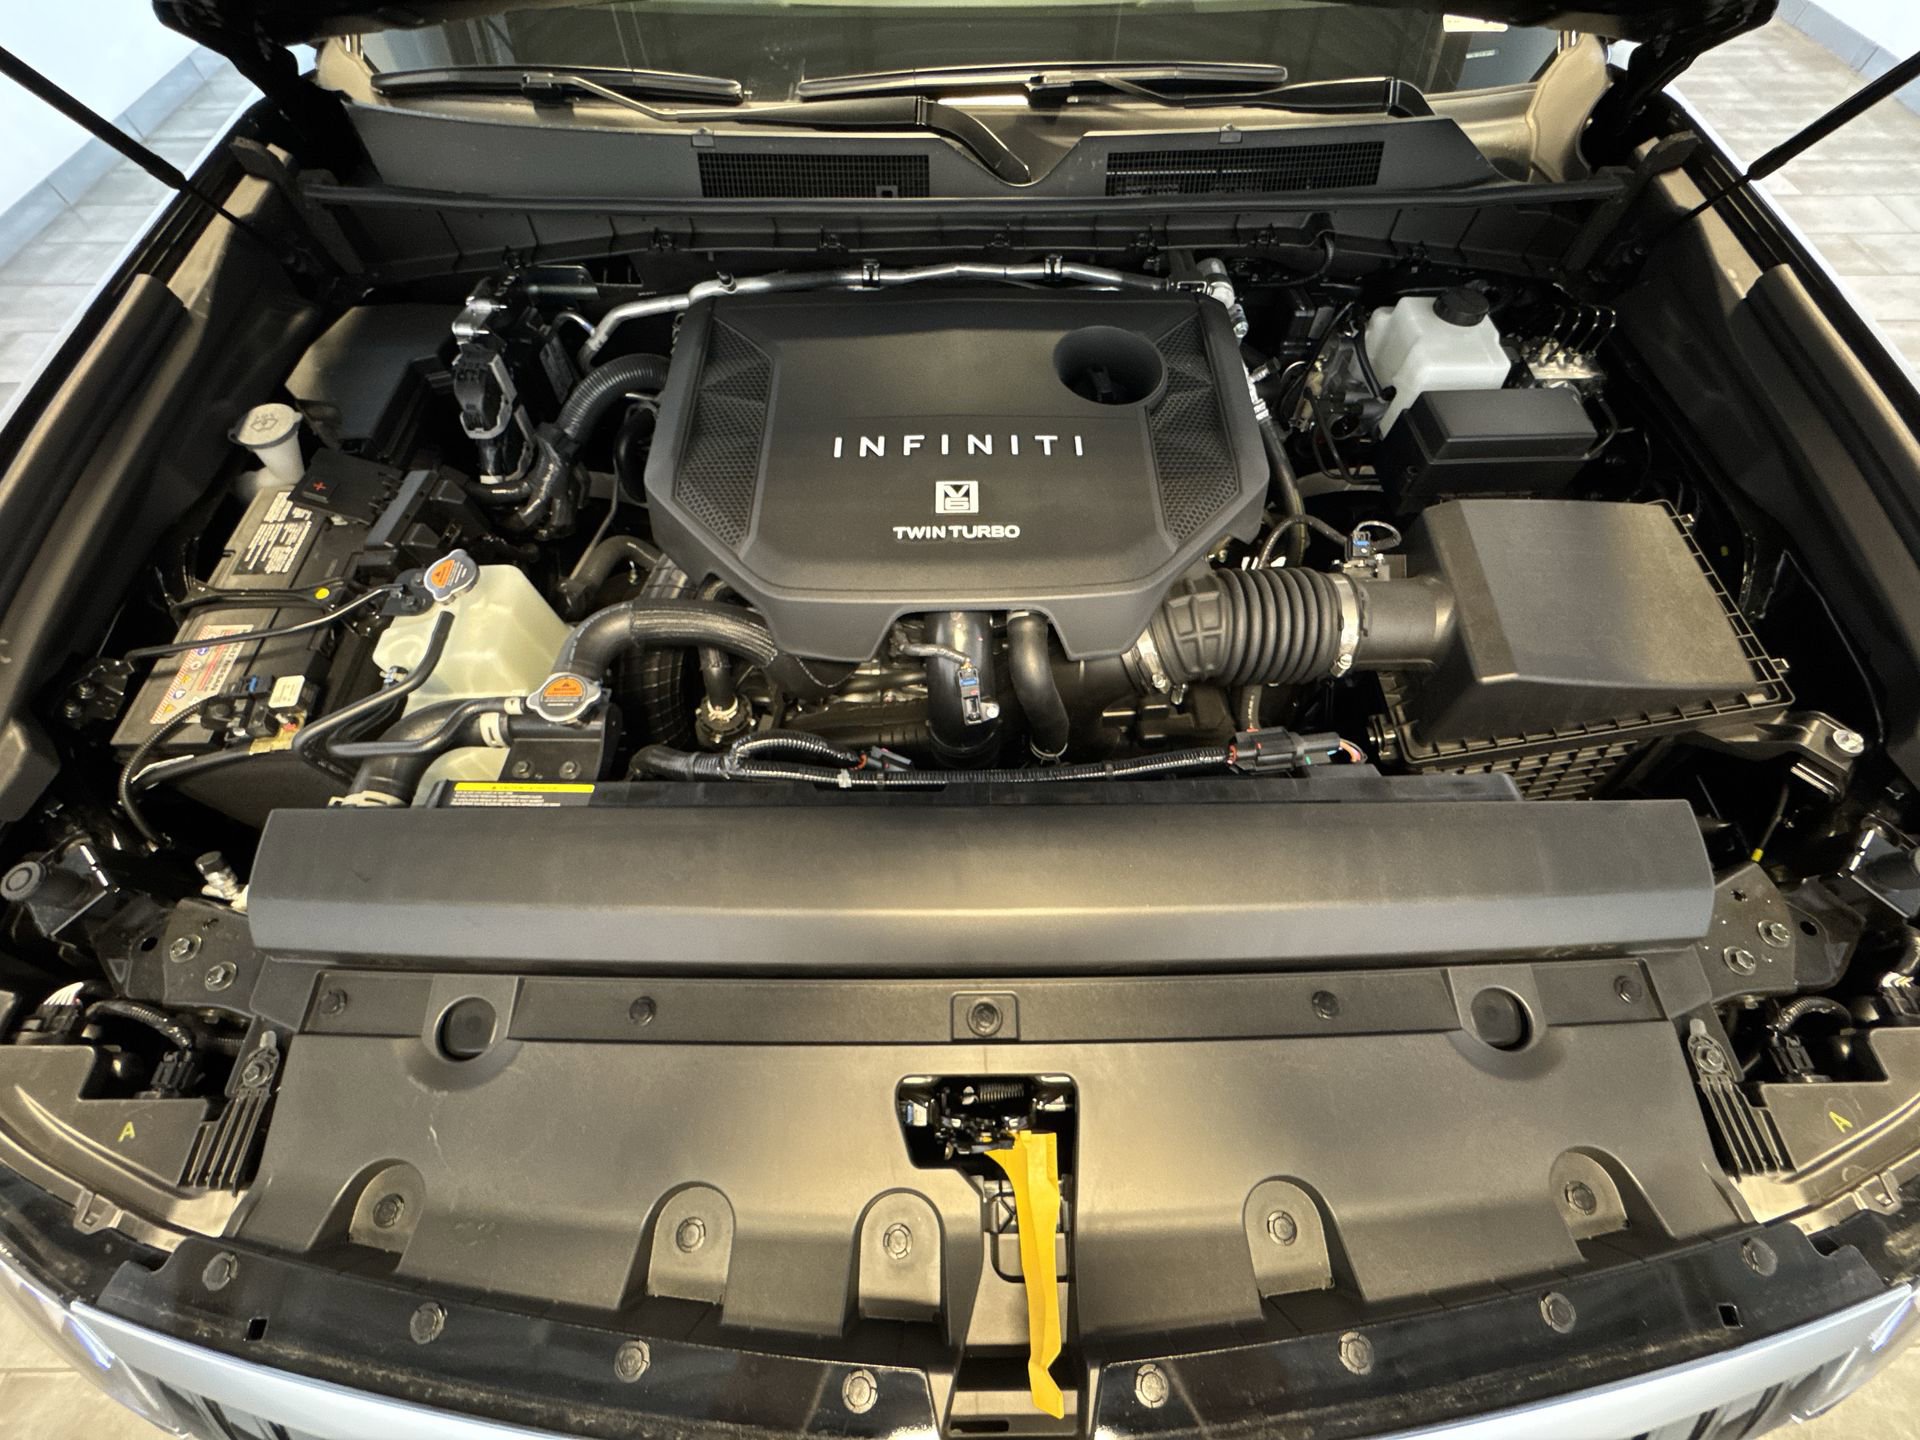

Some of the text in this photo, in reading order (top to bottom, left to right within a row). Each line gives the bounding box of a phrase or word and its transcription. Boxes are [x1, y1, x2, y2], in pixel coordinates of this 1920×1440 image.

[833, 434, 1084, 458] INFINITI
[892, 525, 1021, 540] TWIN TURBO
[117, 1121, 136, 1143] A
[1829, 1111, 1853, 1133] A
